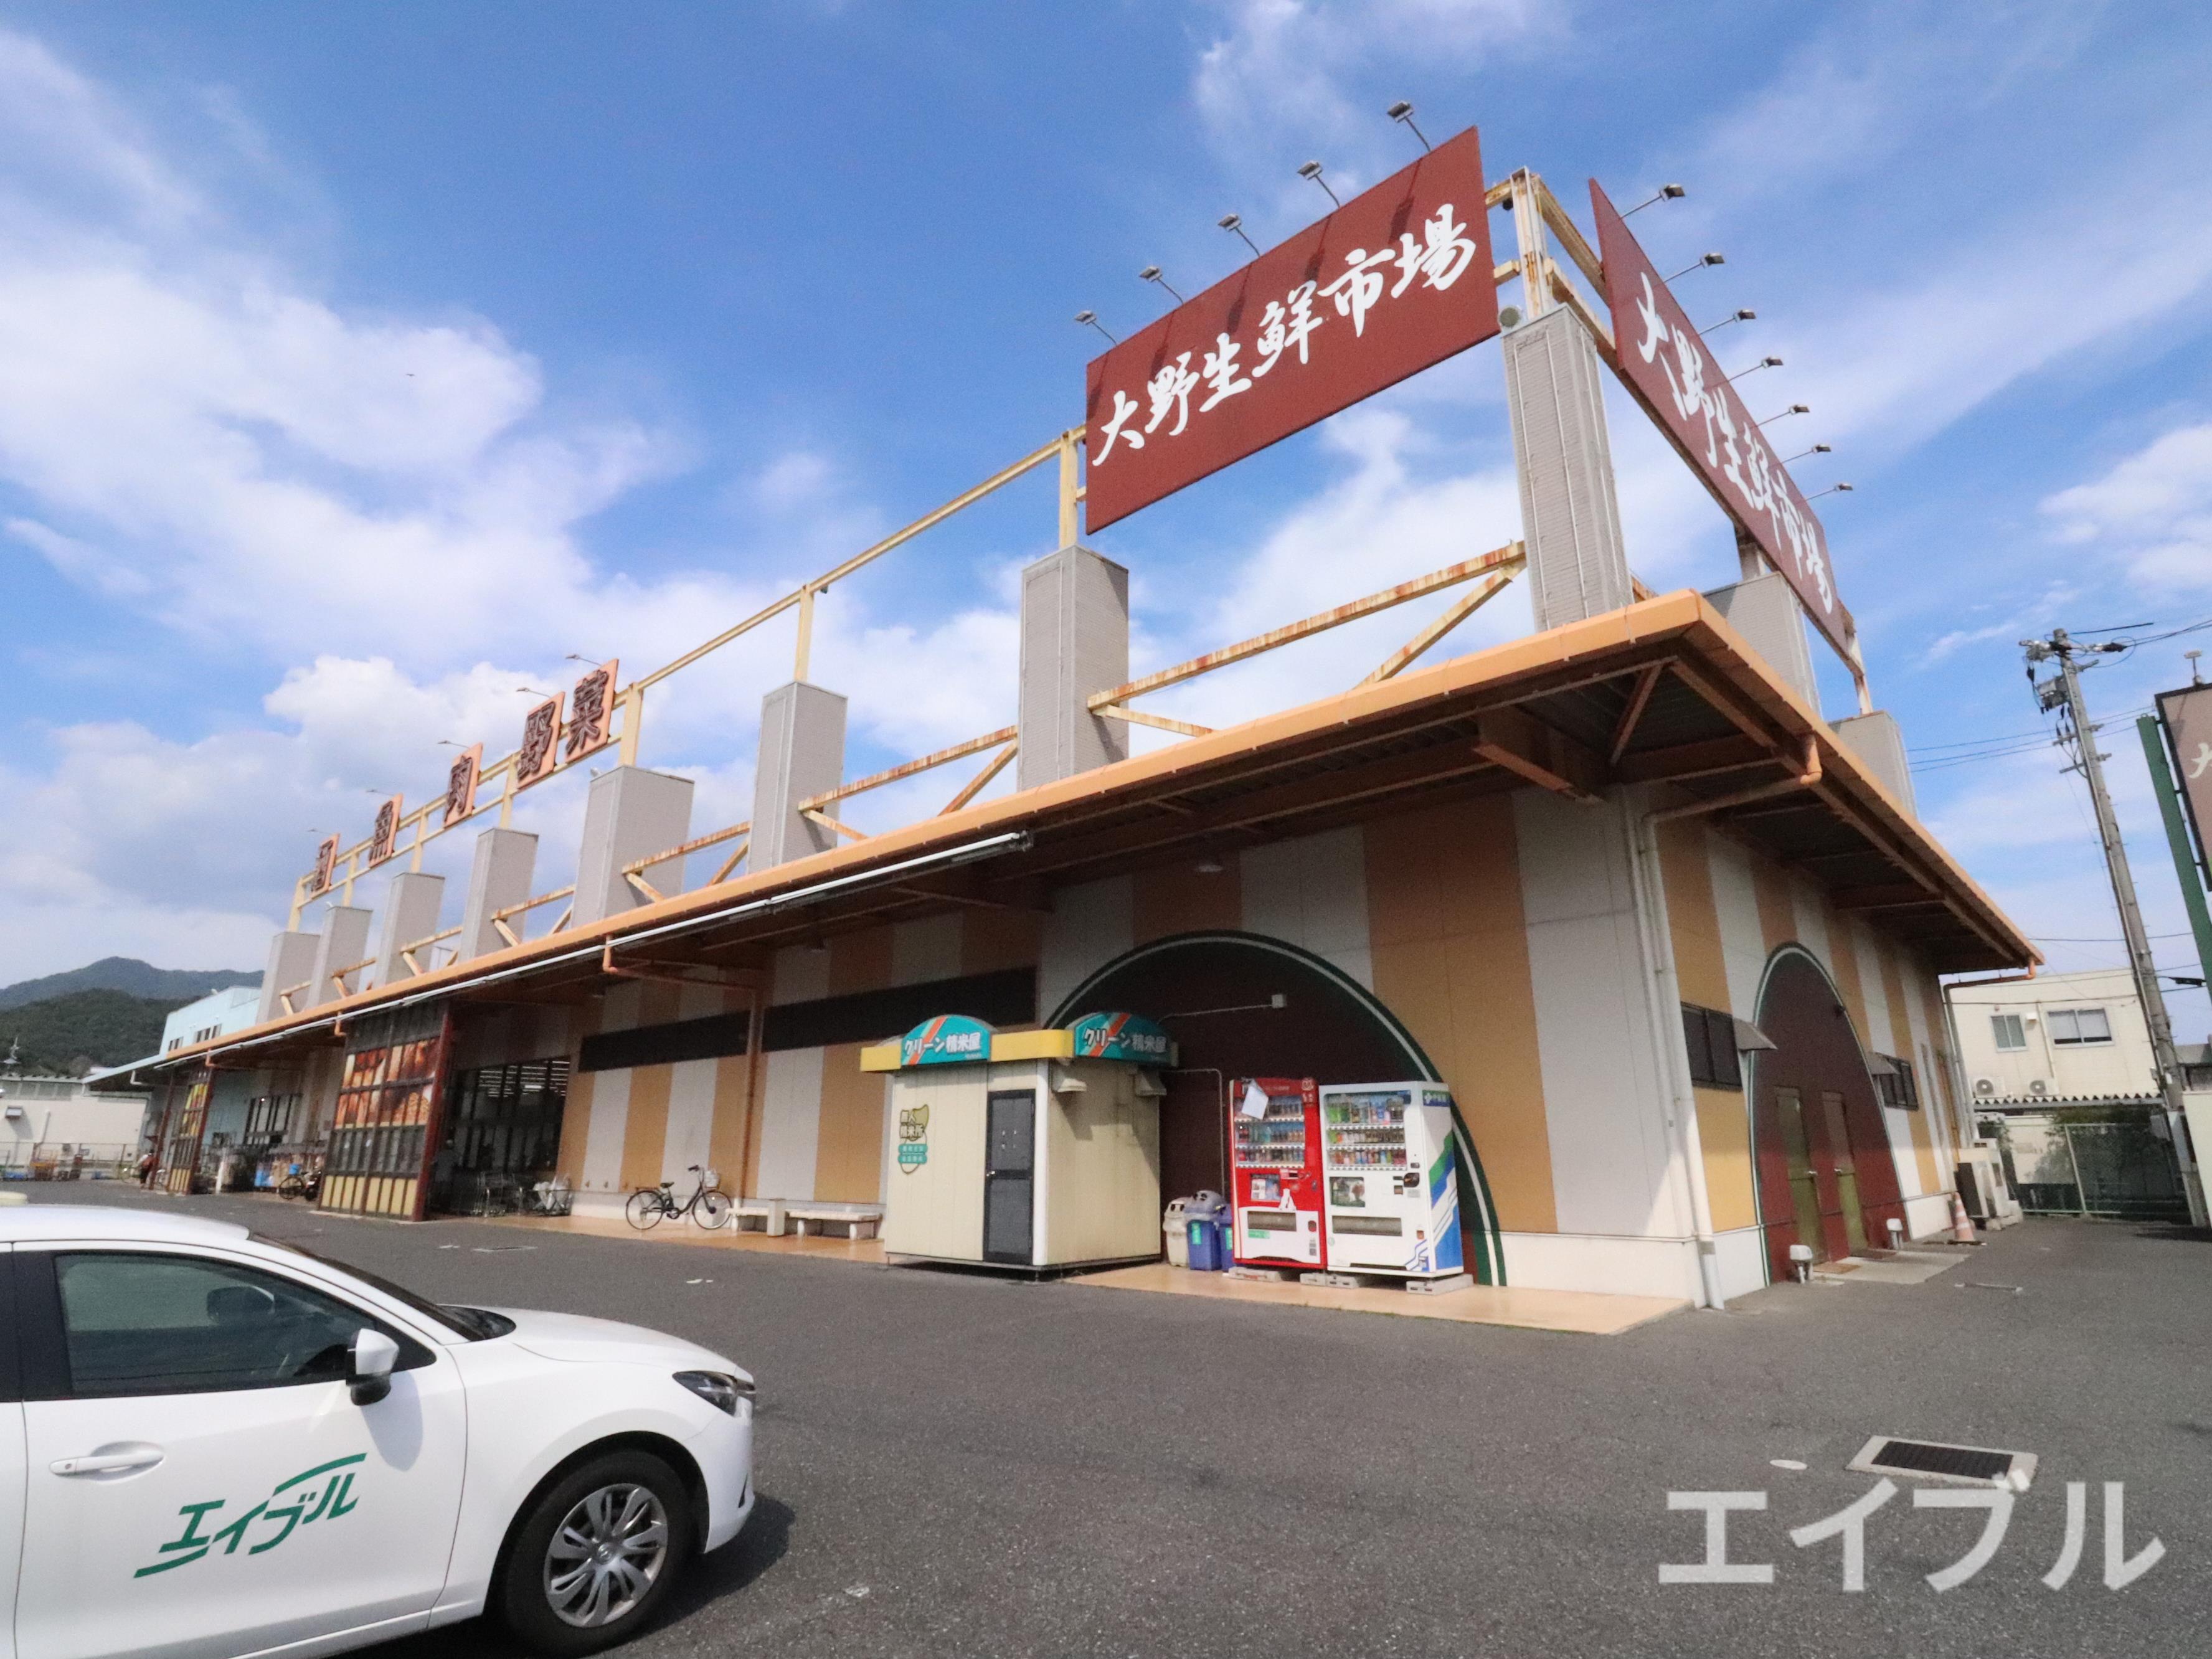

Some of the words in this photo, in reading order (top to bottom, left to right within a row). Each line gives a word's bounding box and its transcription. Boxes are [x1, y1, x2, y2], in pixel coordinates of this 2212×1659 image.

[1092, 203, 1477, 466] 大野生鮮市場
[1636, 272, 1833, 614] 大野生鮮市場
[369, 800, 394, 861] 魚
[444, 755, 473, 822] 肉
[904, 1031, 981, 1056] クリーン精米屋
[1084, 1028, 1167, 1053] クリーン精米屋
[133, 1452, 367, 1579] エイブル
